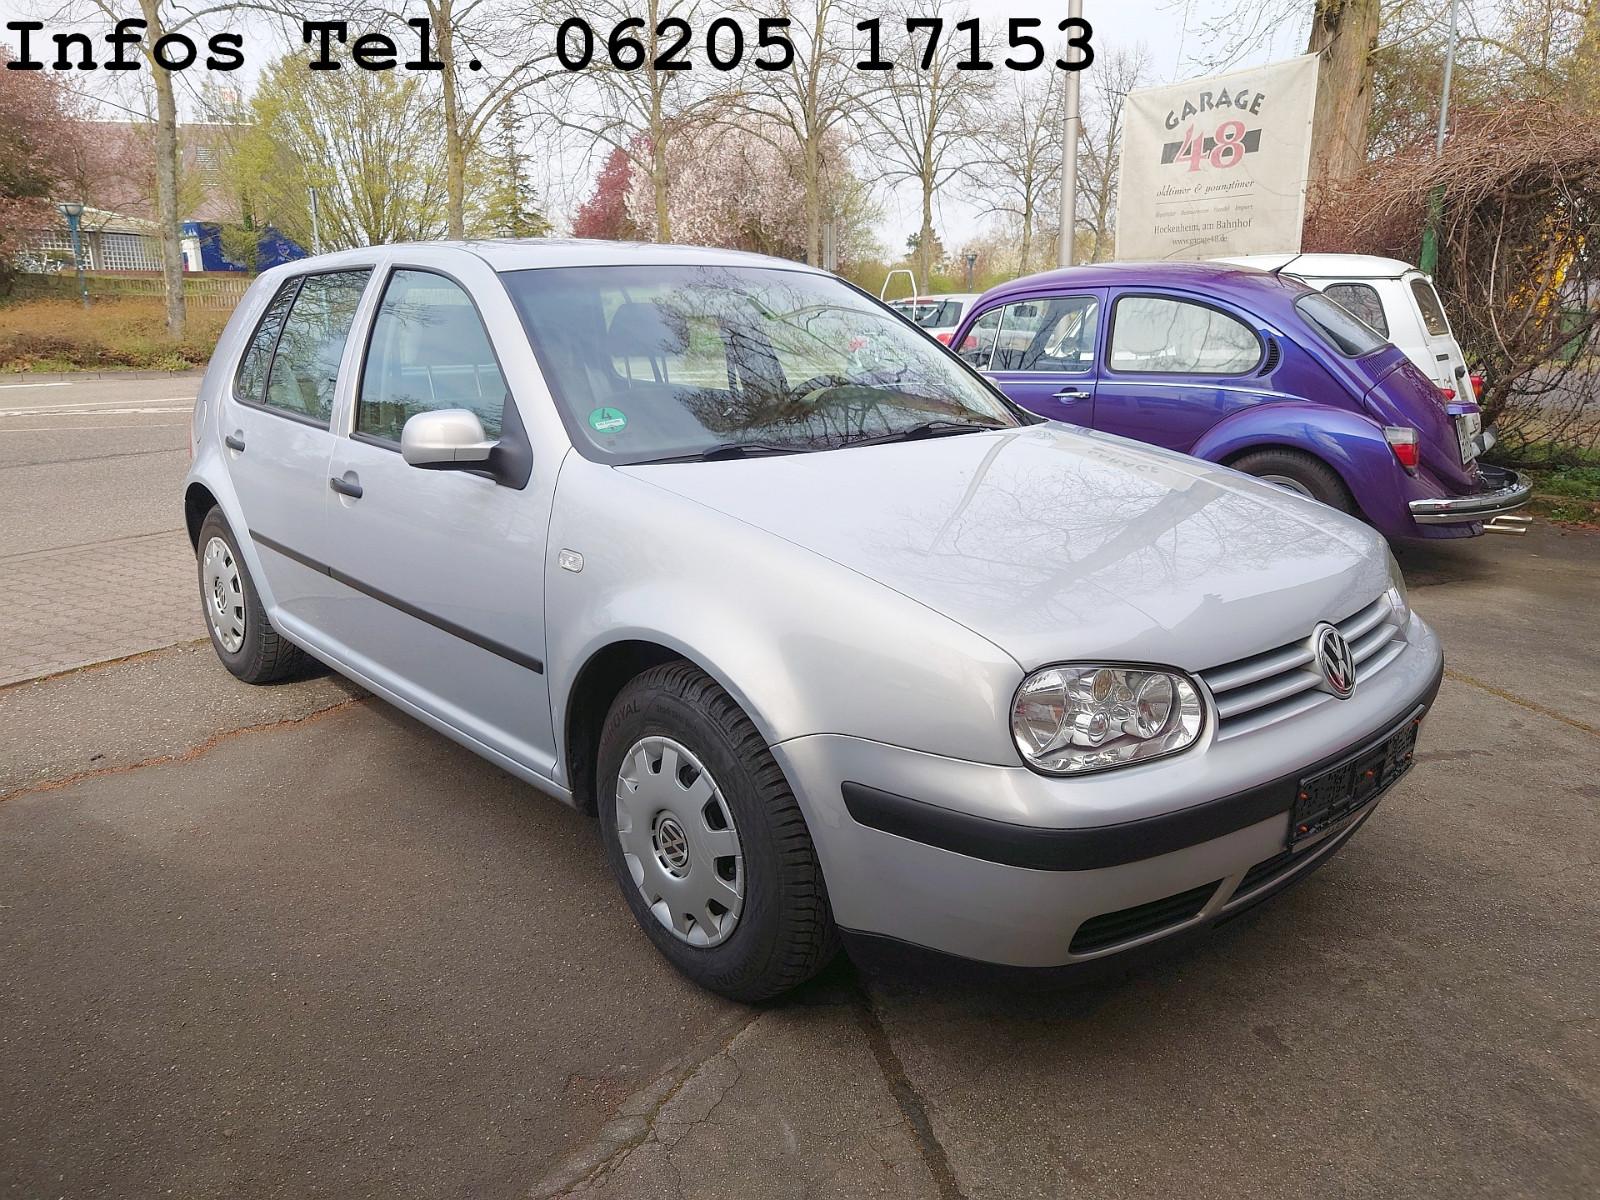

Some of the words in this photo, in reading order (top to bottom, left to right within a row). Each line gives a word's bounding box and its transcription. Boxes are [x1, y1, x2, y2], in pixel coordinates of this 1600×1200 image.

[1164, 87, 1266, 130] GARAGE
[1174, 120, 1246, 173] 48
[1216, 218, 1252, 229] Bahnhof
